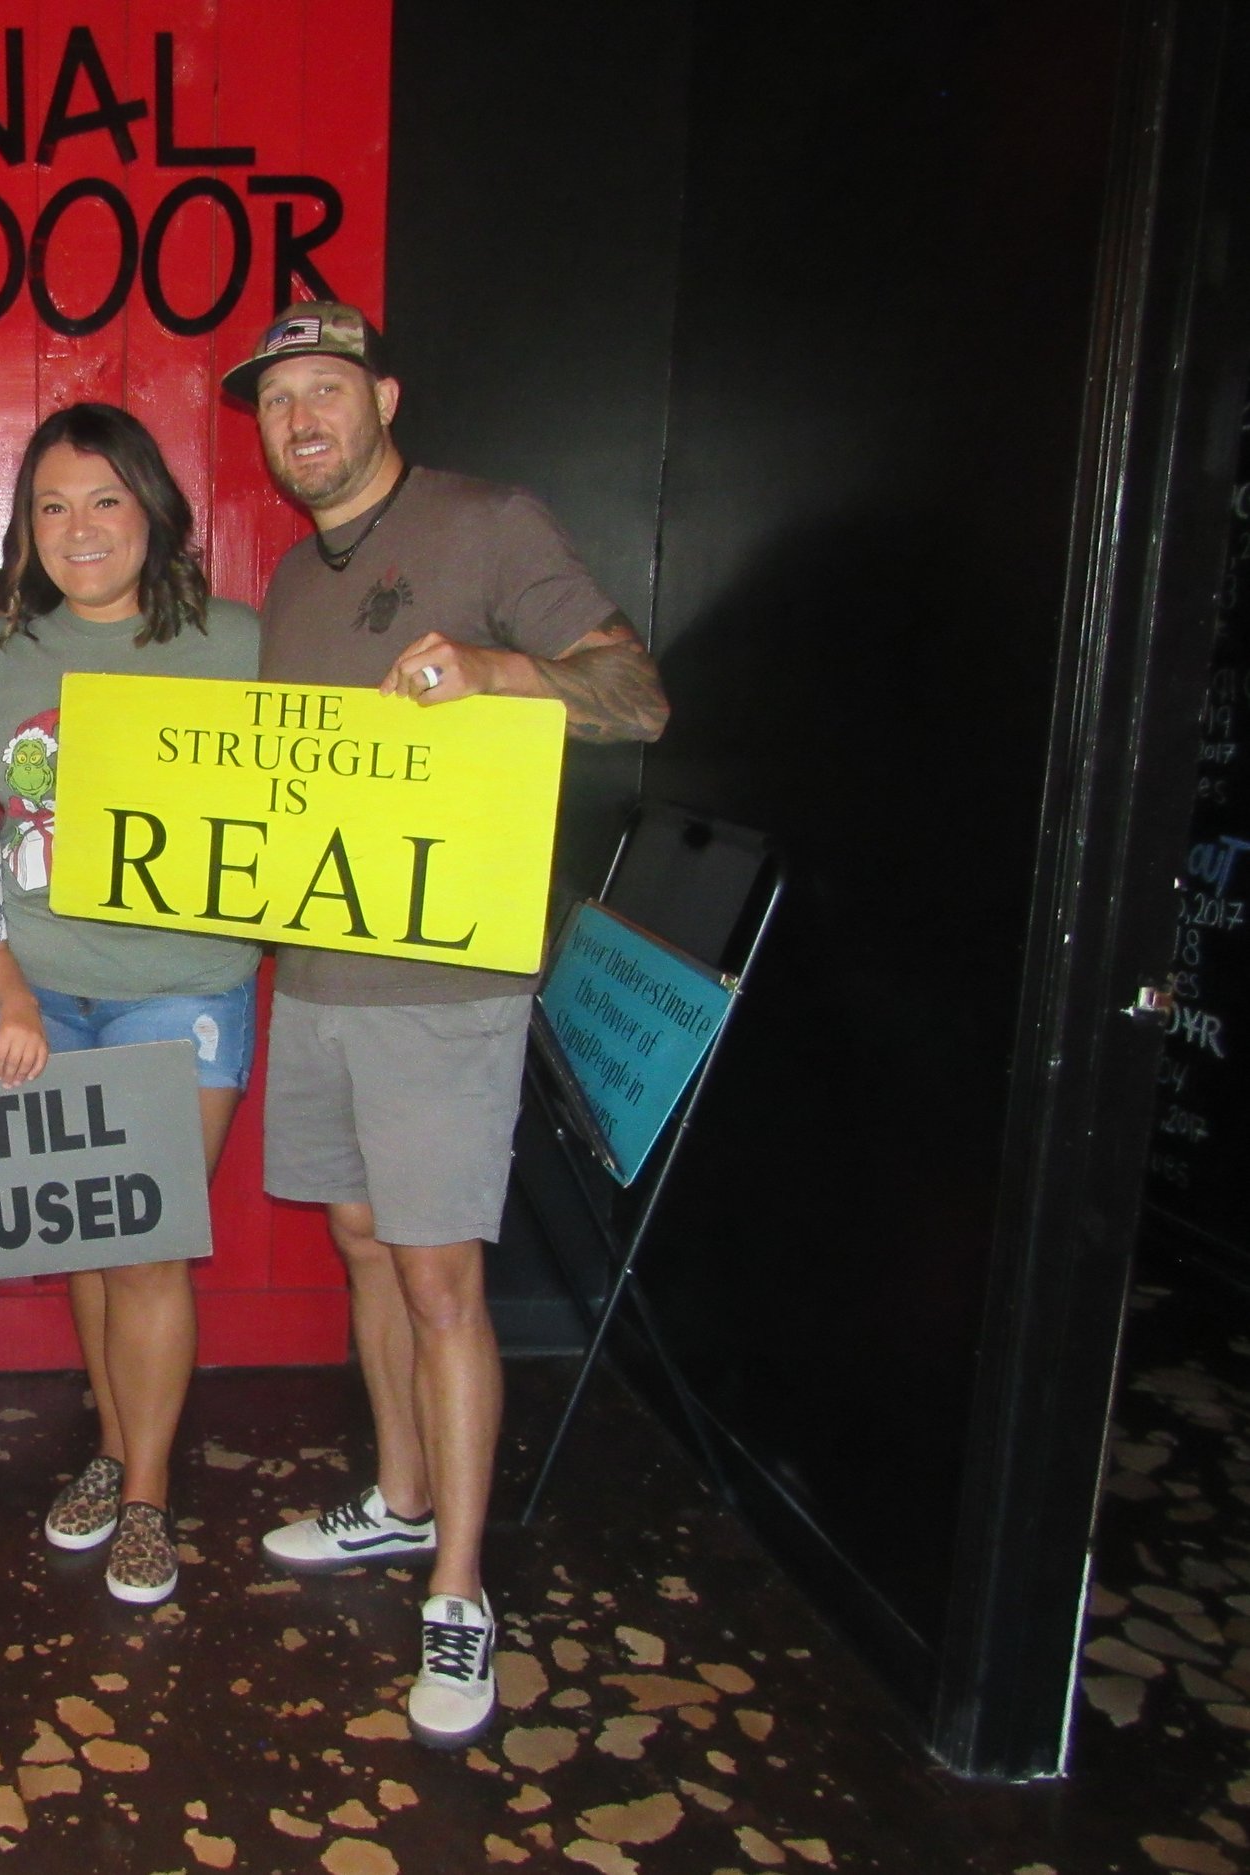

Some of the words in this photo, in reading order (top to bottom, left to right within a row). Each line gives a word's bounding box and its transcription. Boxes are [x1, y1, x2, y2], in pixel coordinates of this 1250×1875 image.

[244, 690, 344, 732] THE
[156, 727, 432, 783] STRUGGLE
[266, 777, 309, 816] IS
[97, 807, 479, 952] REAL
[574, 975, 597, 1009] the
[593, 991, 642, 1043] Power
[637, 1029, 664, 1058] of
[605, 946, 712, 1041] Underestimate
[586, 1041, 630, 1090] People
[625, 1071, 645, 1108] in
